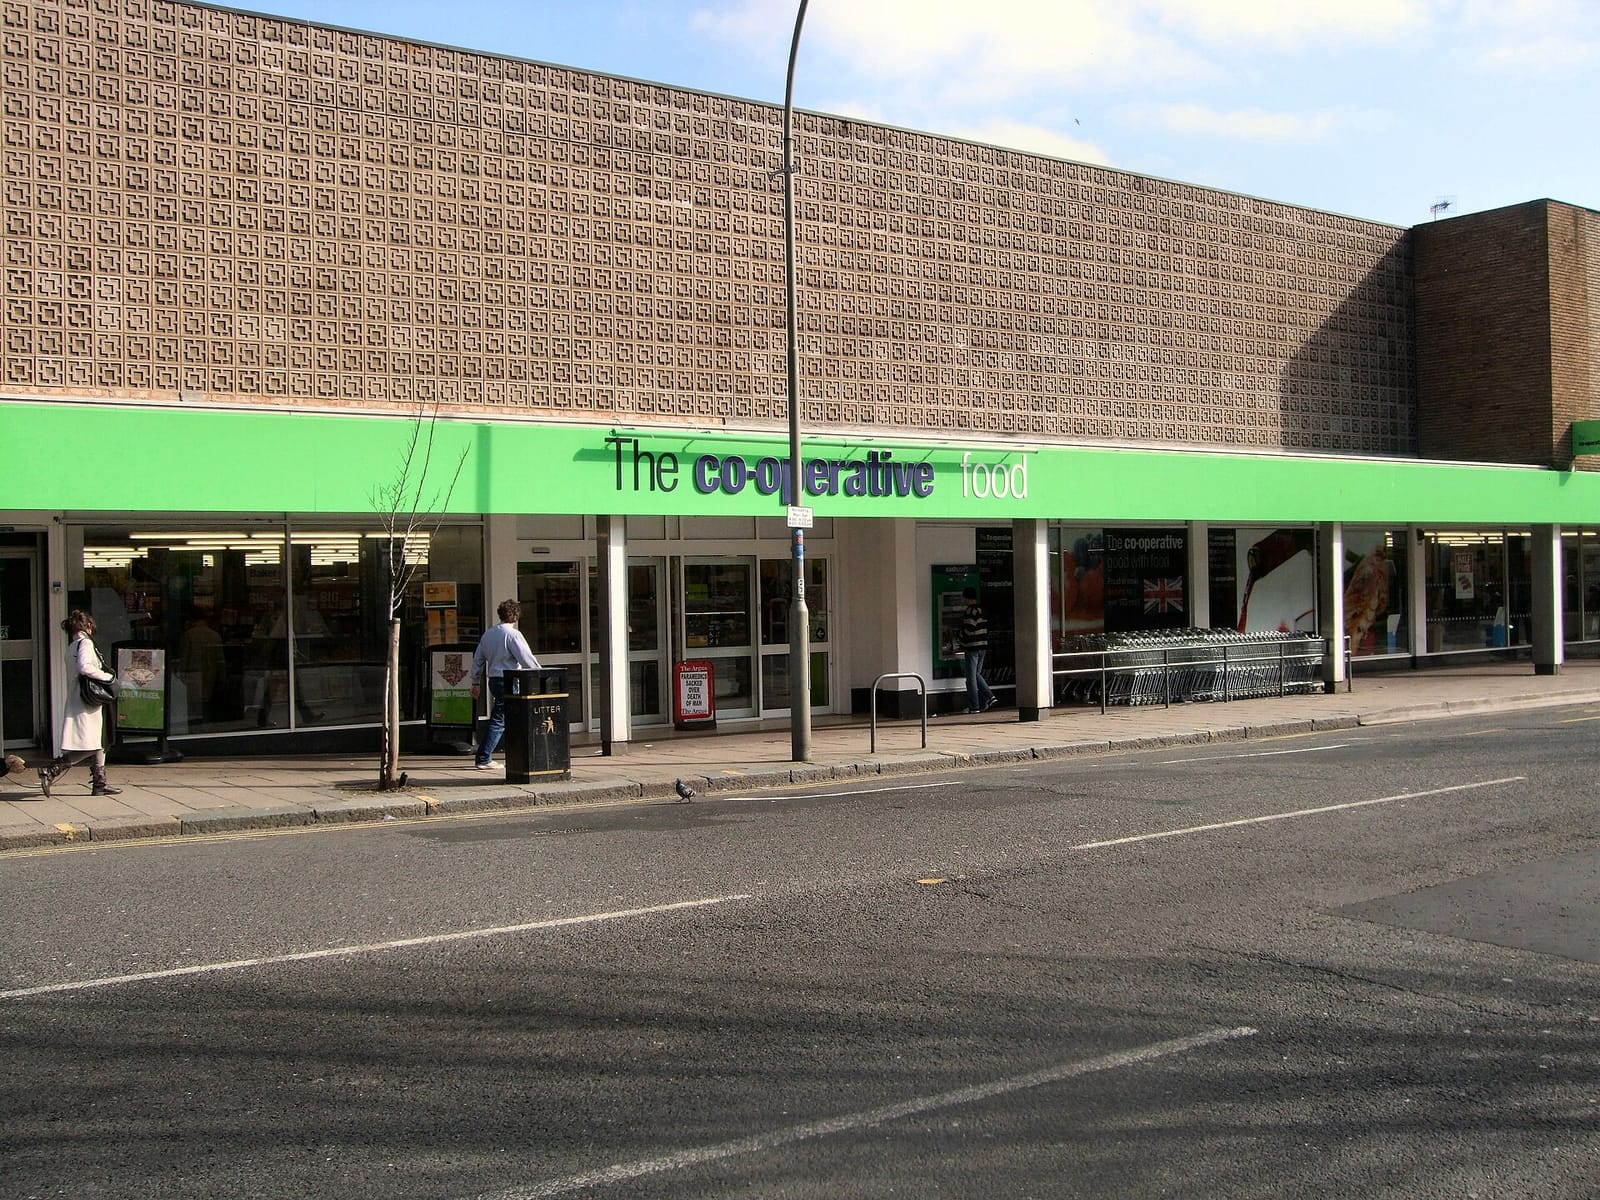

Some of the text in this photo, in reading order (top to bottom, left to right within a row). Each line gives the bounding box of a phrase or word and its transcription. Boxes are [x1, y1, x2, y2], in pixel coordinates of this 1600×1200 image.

[604, 437, 1028, 505] The co-operative food
[1106, 534, 1184, 552] The co-operative
[534, 705, 561, 714] LITTER
